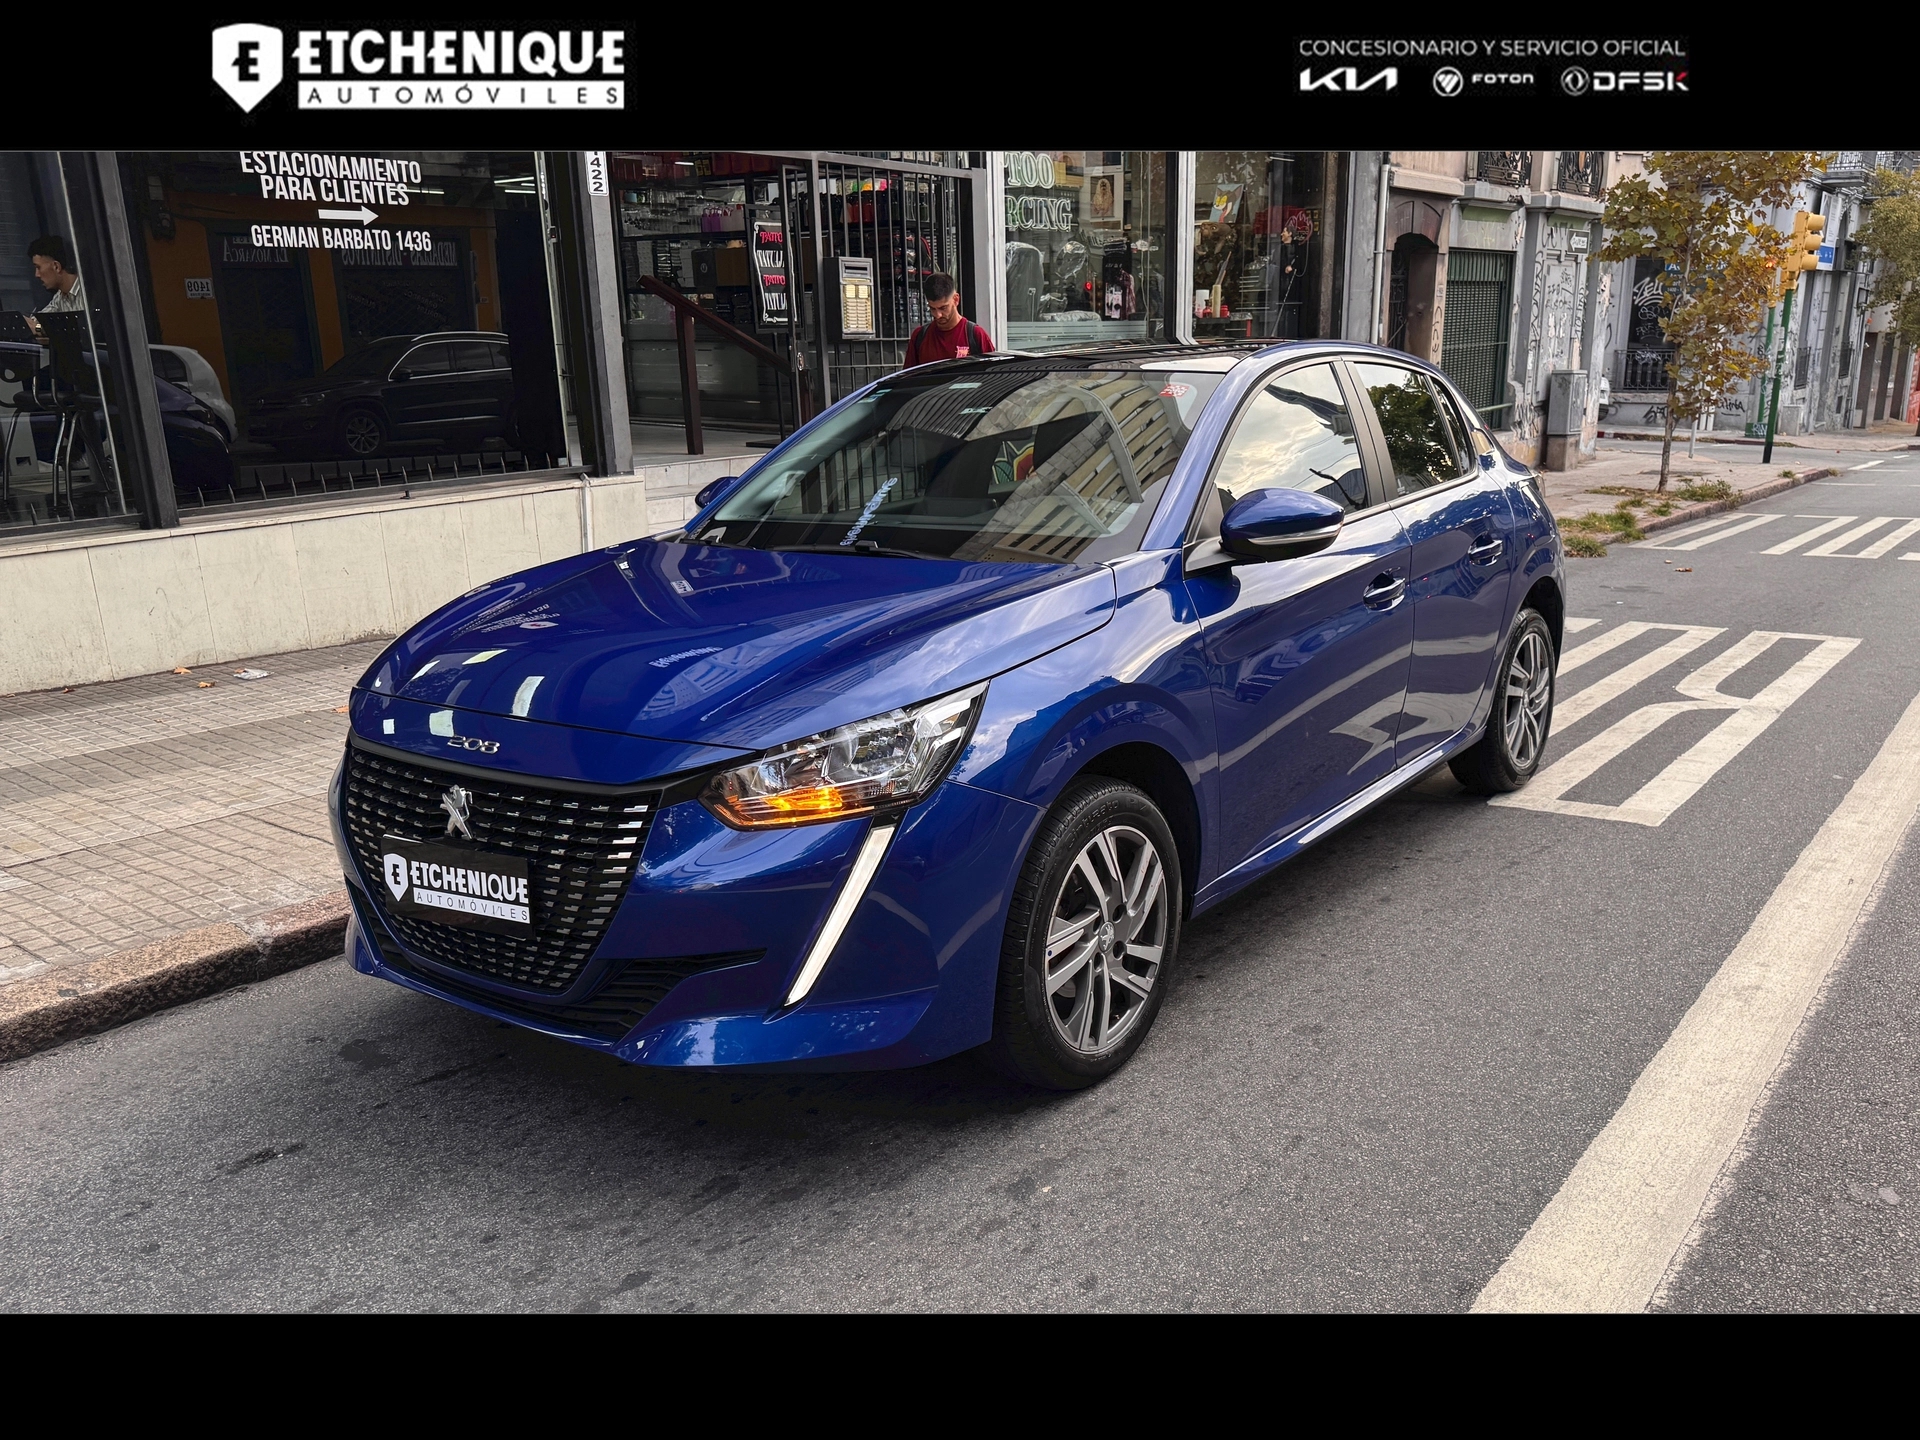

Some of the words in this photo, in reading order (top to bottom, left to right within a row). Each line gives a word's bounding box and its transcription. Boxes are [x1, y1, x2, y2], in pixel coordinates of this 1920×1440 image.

[240, 151, 422, 184] ESTACIONAMIENTO
[590, 151, 604, 192] 422
[260, 175, 317, 201] PARA
[320, 178, 410, 206] CLIENTES
[250, 225, 320, 248] GERMAN
[322, 227, 392, 250] BARBATO
[396, 230, 432, 252] 1436
[447, 735, 500, 754] 208
[410, 860, 529, 904] ETCHENIQUE
[416, 891, 528, 921] AUTOMÓVILES
